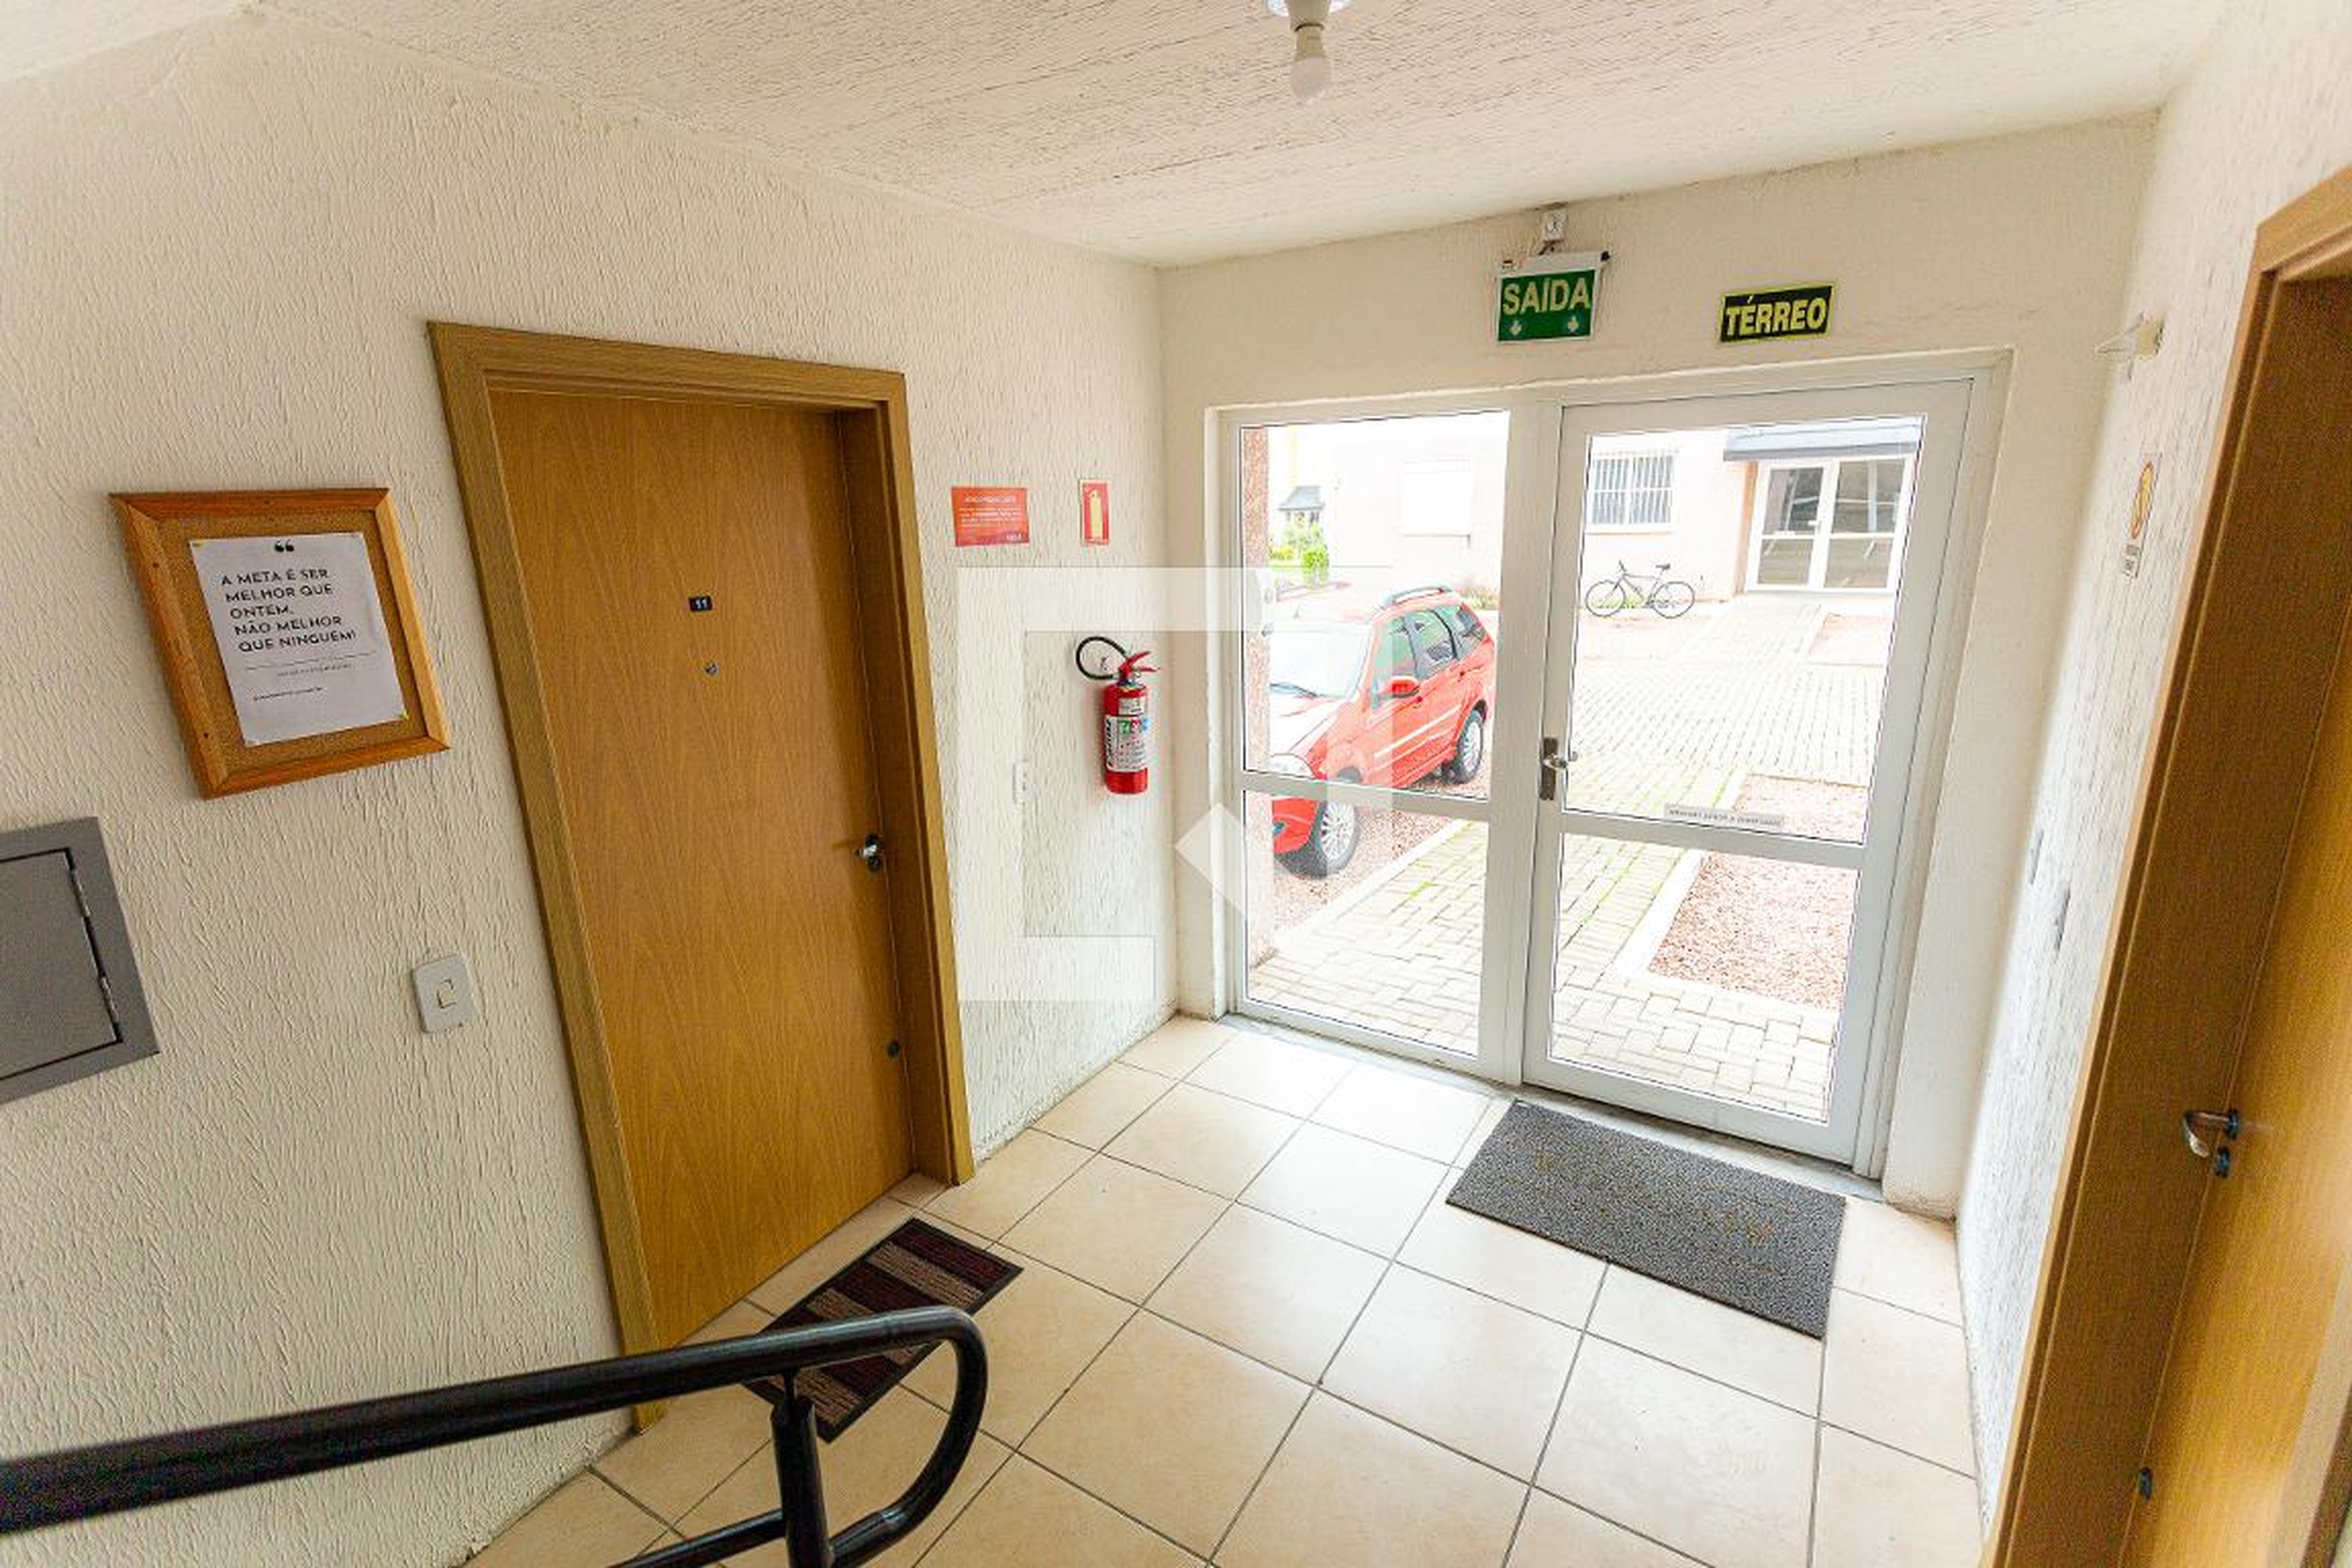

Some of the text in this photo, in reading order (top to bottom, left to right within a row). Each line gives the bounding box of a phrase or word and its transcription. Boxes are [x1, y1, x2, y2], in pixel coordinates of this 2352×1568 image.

[1726, 295, 1827, 336] TÉRREO
[222, 575, 232, 586] A
[236, 570, 282, 585] META
[300, 568, 328, 579] SER
[225, 583, 333, 603] MELHOR QUE
[235, 616, 342, 636] NÃO MELHOR
[238, 638, 274, 652] QUE
